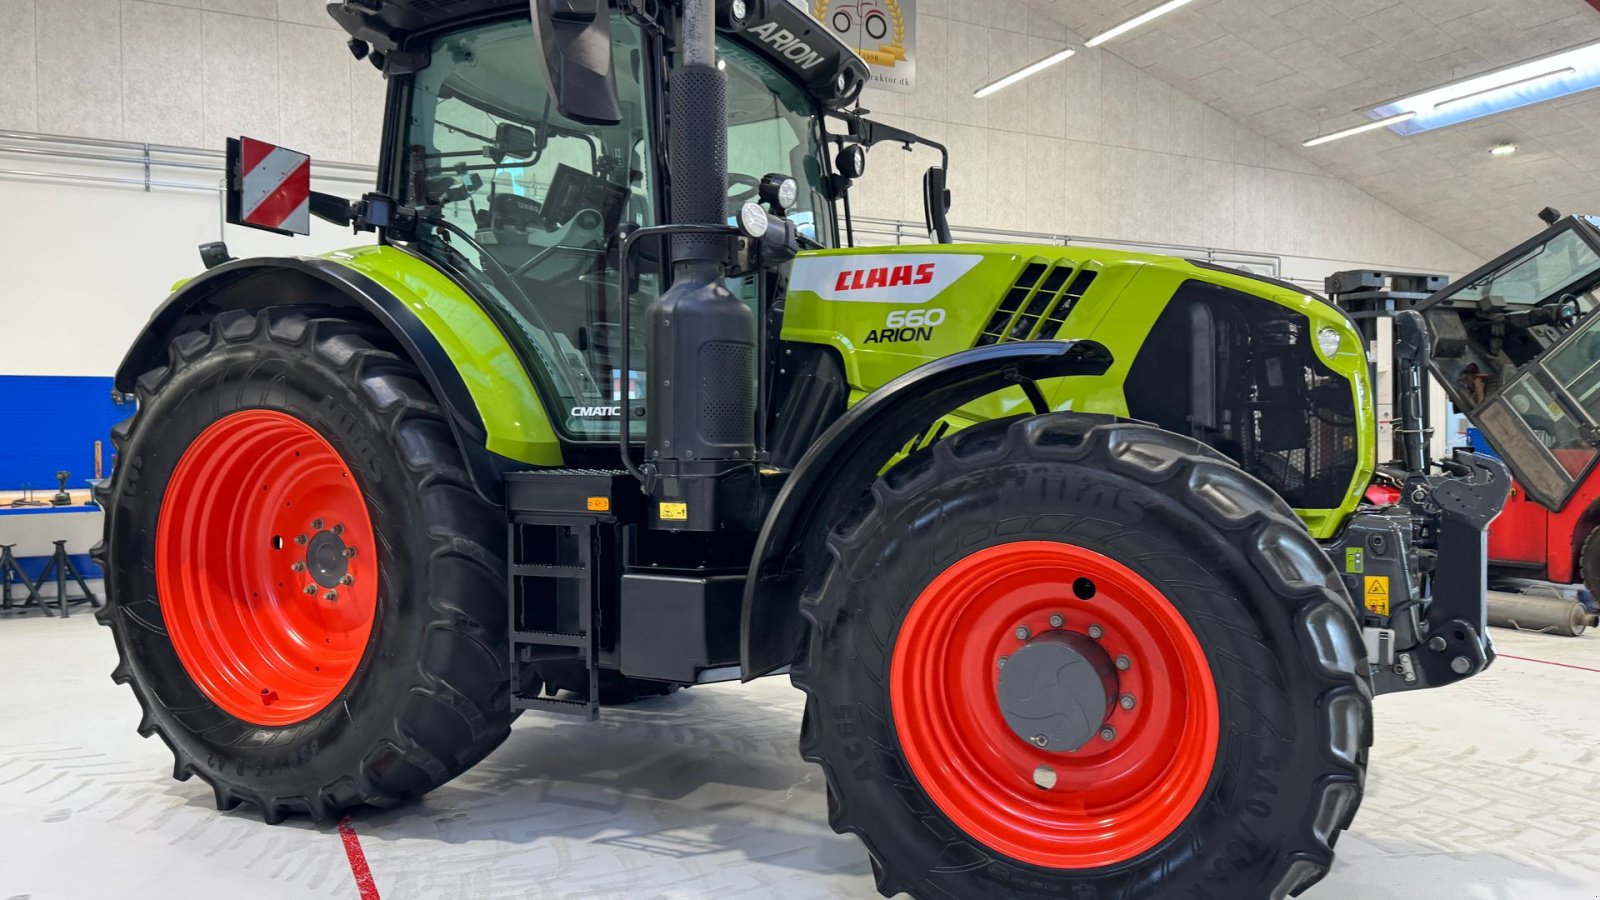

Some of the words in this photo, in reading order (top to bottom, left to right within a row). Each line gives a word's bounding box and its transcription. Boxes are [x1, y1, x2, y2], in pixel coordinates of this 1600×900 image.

[748, 21, 824, 70] ARION
[869, 73, 910, 87] raktor.dk
[834, 262, 936, 291] CLAAS
[886, 308, 946, 329] 660
[863, 326, 934, 344] ARION
[571, 406, 621, 416] CMATIC
